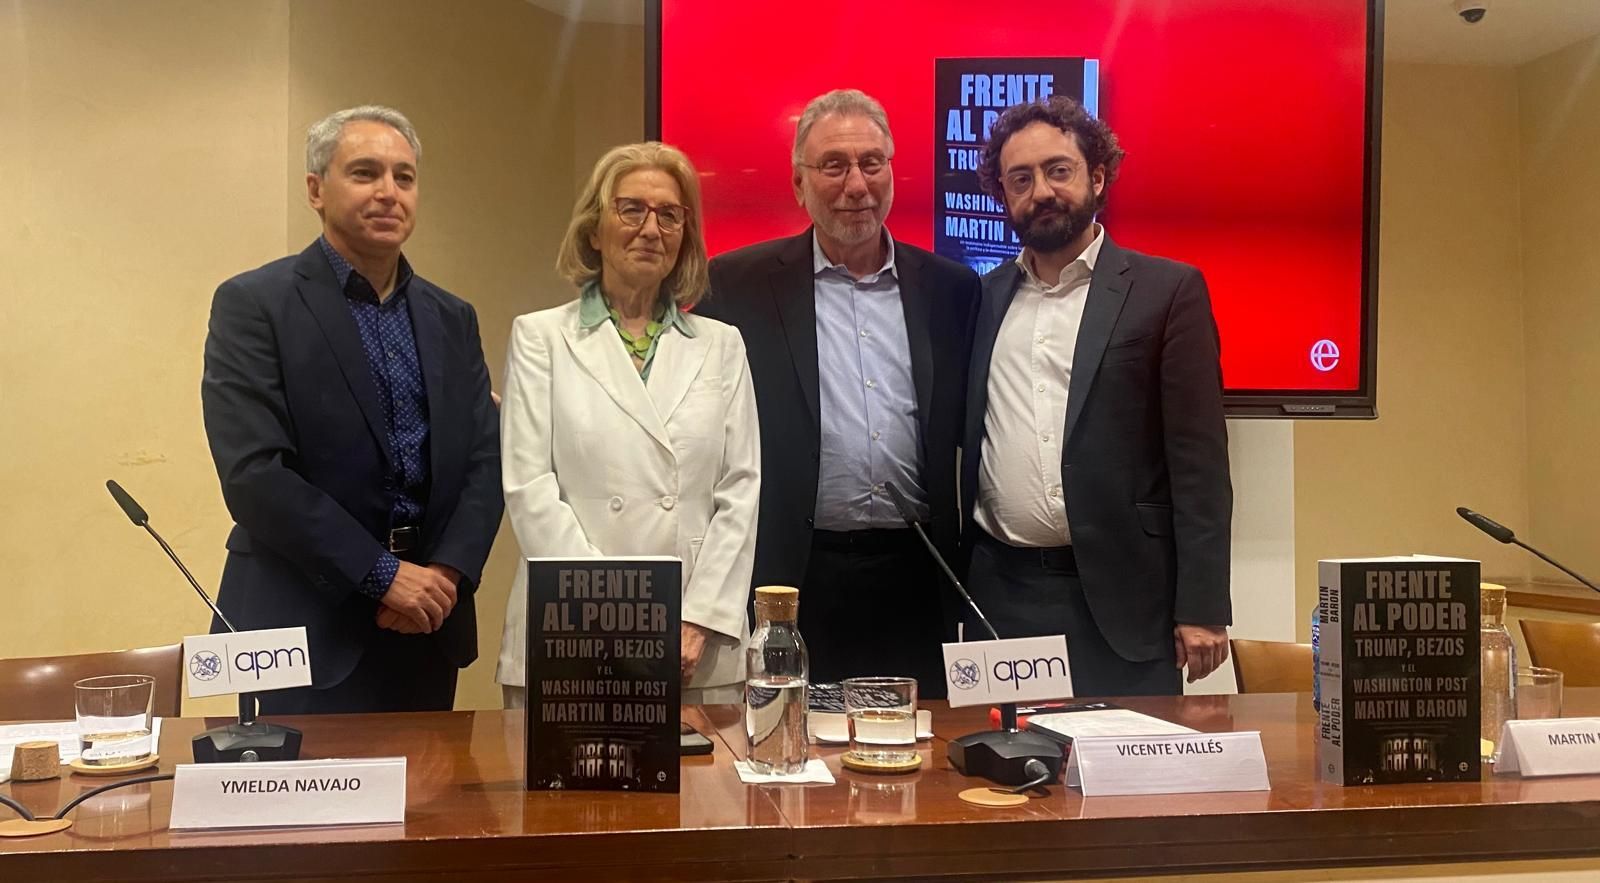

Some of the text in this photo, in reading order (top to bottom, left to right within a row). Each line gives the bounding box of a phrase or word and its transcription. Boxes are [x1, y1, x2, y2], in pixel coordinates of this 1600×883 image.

[961, 74, 1054, 107] FRENTE
[946, 109, 976, 141] AL
[948, 149, 982, 170] TRU
[945, 216, 1004, 242] MARTIN
[558, 569, 652, 599] FRENTE
[1366, 570, 1451, 599] FRENTE
[542, 602, 668, 632] AL PODER
[1319, 586, 1328, 624] MARTIN
[1330, 589, 1339, 623] BARON
[1353, 602, 1467, 632] AL PODER
[545, 639, 665, 660] TRUMP, BEZOS
[1355, 638, 1464, 659] TRUMP, BEZOS
[235, 647, 306, 680] apm
[597, 666, 613, 676] Y EL
[994, 657, 1066, 691] apm
[1401, 664, 1416, 673] Y EL
[541, 680, 668, 697] WASHINGTON POST
[1353, 677, 1468, 694] WASHINGTON POST
[542, 703, 667, 724] MARTIN BARON
[1321, 702, 1331, 740] FRENTE
[1331, 698, 1341, 747] AL PODER
[1354, 700, 1467, 720] MARTIN BARON
[1116, 739, 1223, 756] VICENTE VALLÉS
[1548, 732, 1595, 745] MARTIN
[221, 778, 361, 793] YMELDA NAVAJO
